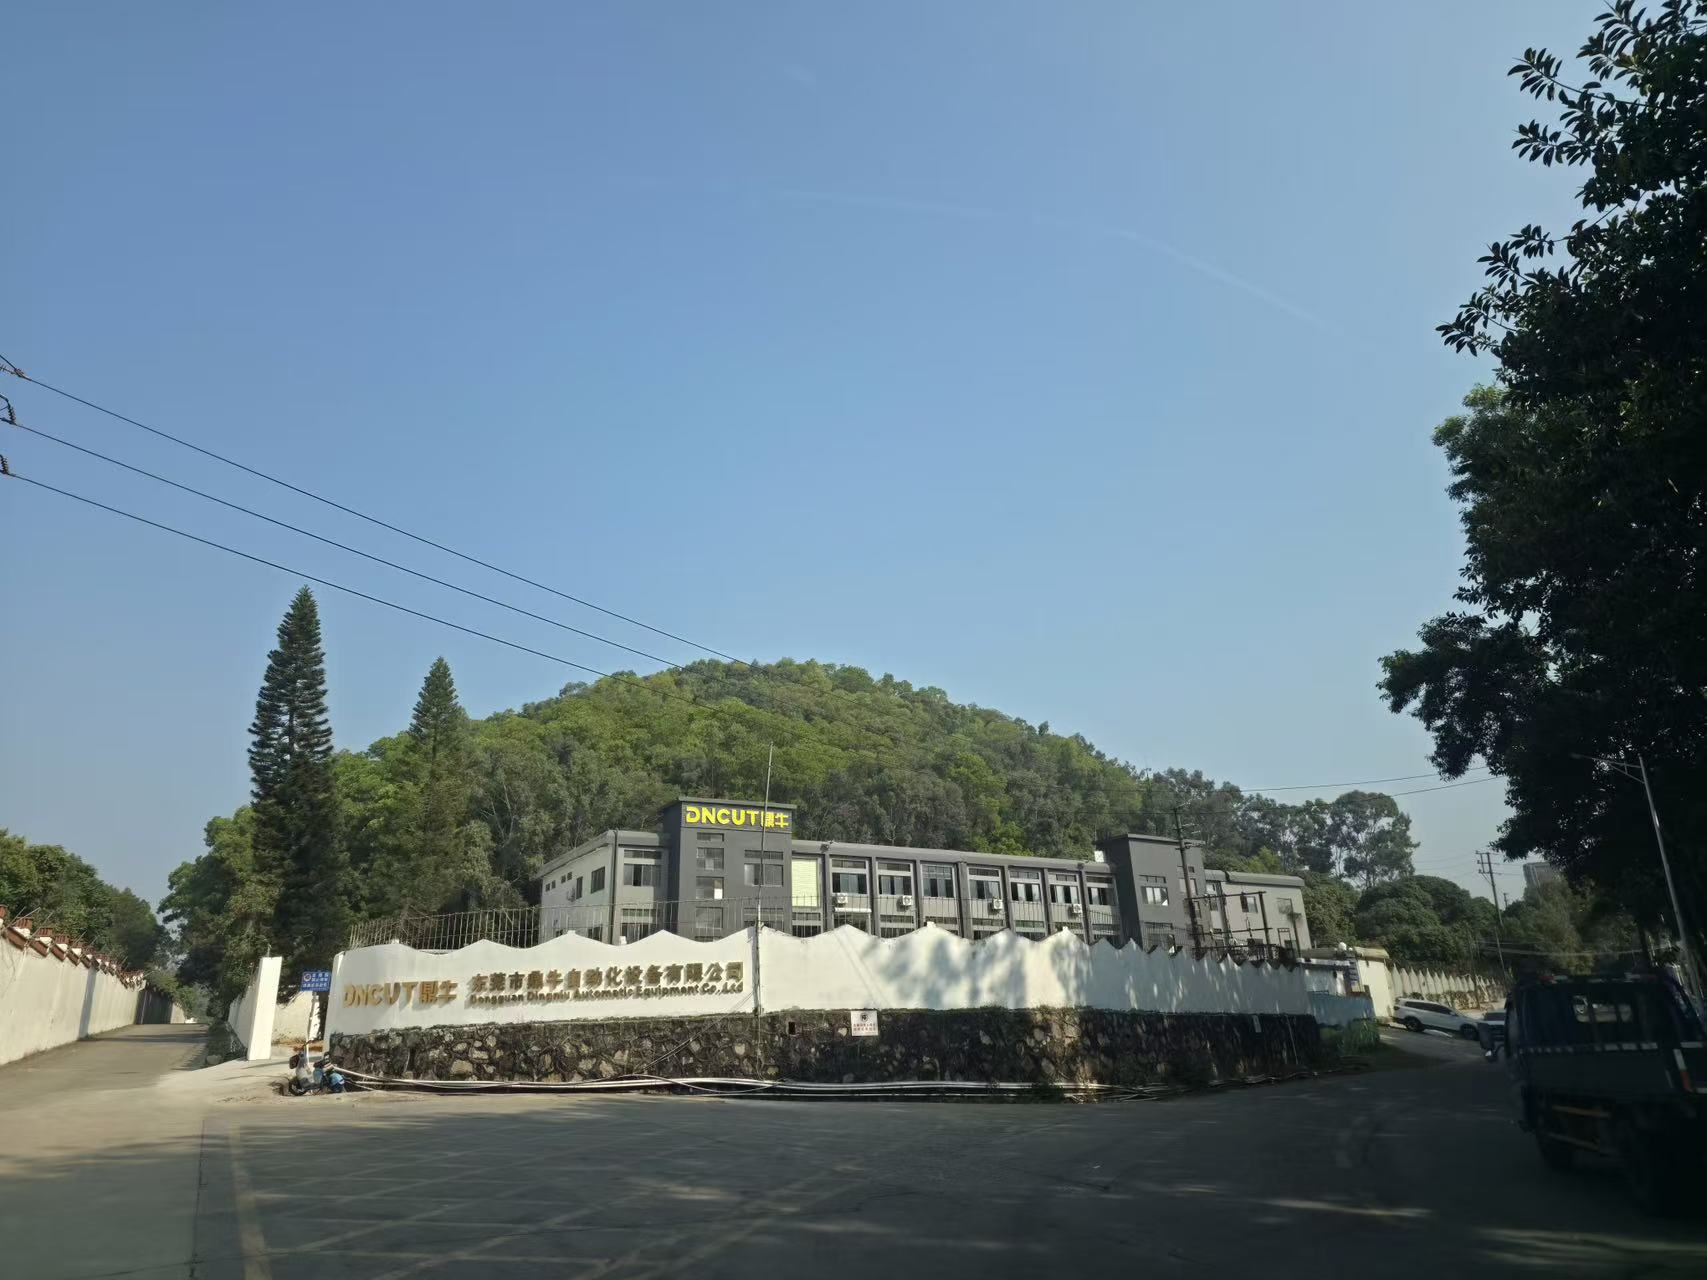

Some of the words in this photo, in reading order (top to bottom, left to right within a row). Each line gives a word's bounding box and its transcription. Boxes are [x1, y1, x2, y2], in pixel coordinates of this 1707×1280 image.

[472, 962, 743, 992] 东莞市鼎牛自动化设备有限公司
[470, 994, 524, 1005] Dongguan
[527, 990, 570, 1002] Dingniu
[639, 984, 699, 999] Equipment
